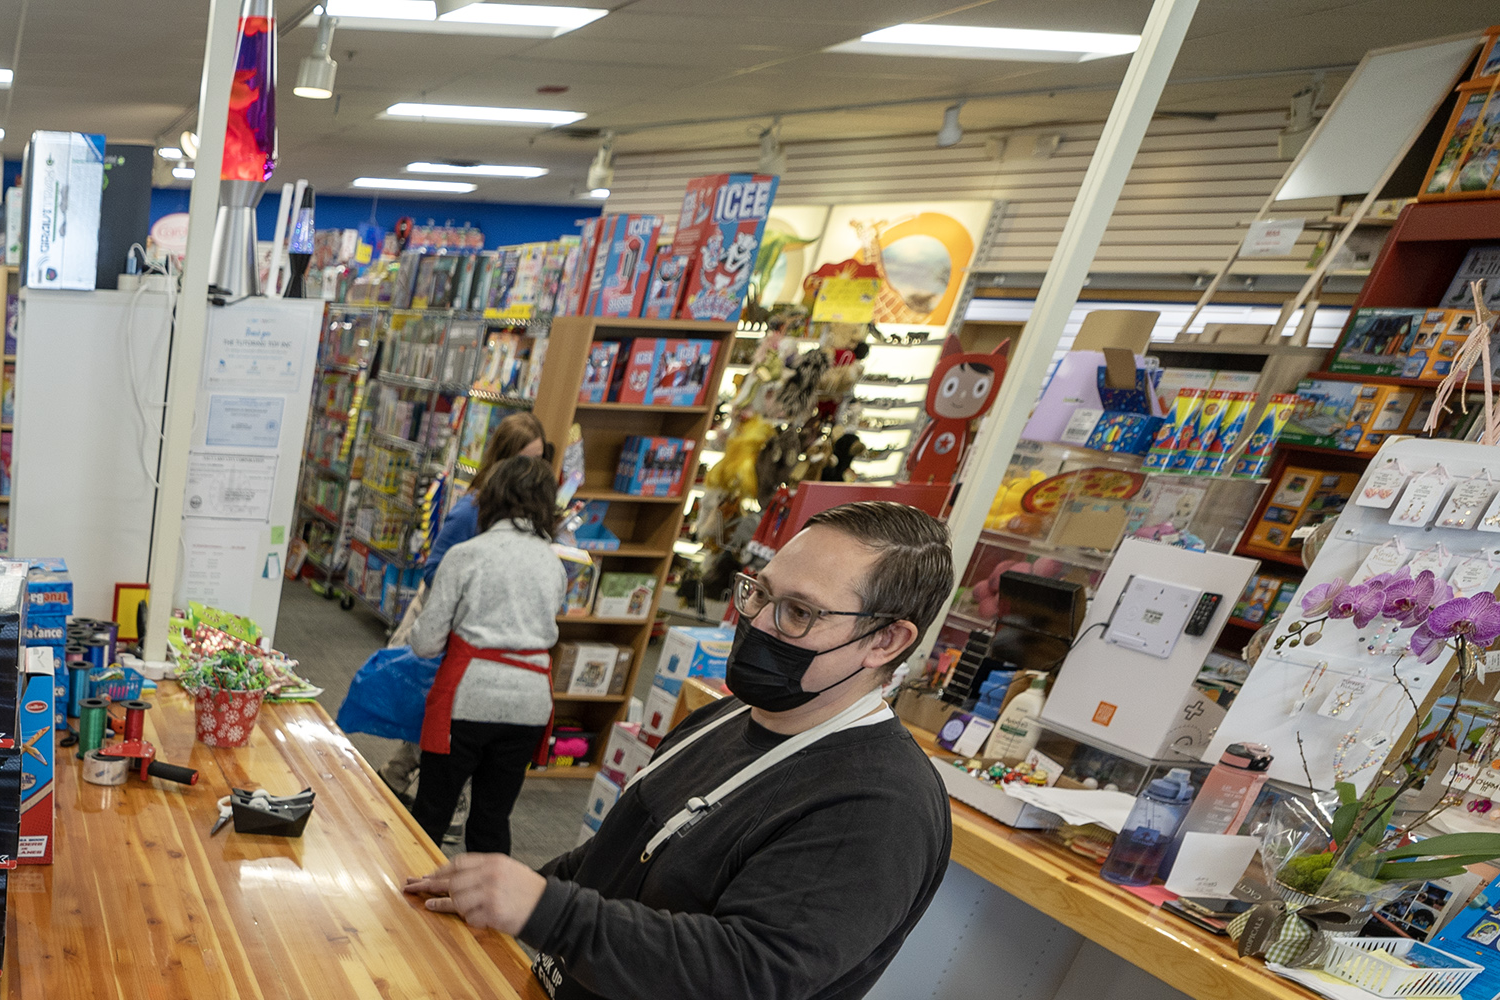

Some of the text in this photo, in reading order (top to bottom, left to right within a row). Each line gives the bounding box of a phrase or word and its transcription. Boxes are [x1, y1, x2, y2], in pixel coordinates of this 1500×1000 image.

[713, 181, 774, 221] ICEE
[628, 218, 653, 236] ICEE
[1475, 778, 1499, 792] CHARM
[1236, 882, 1263, 901] CACTI
